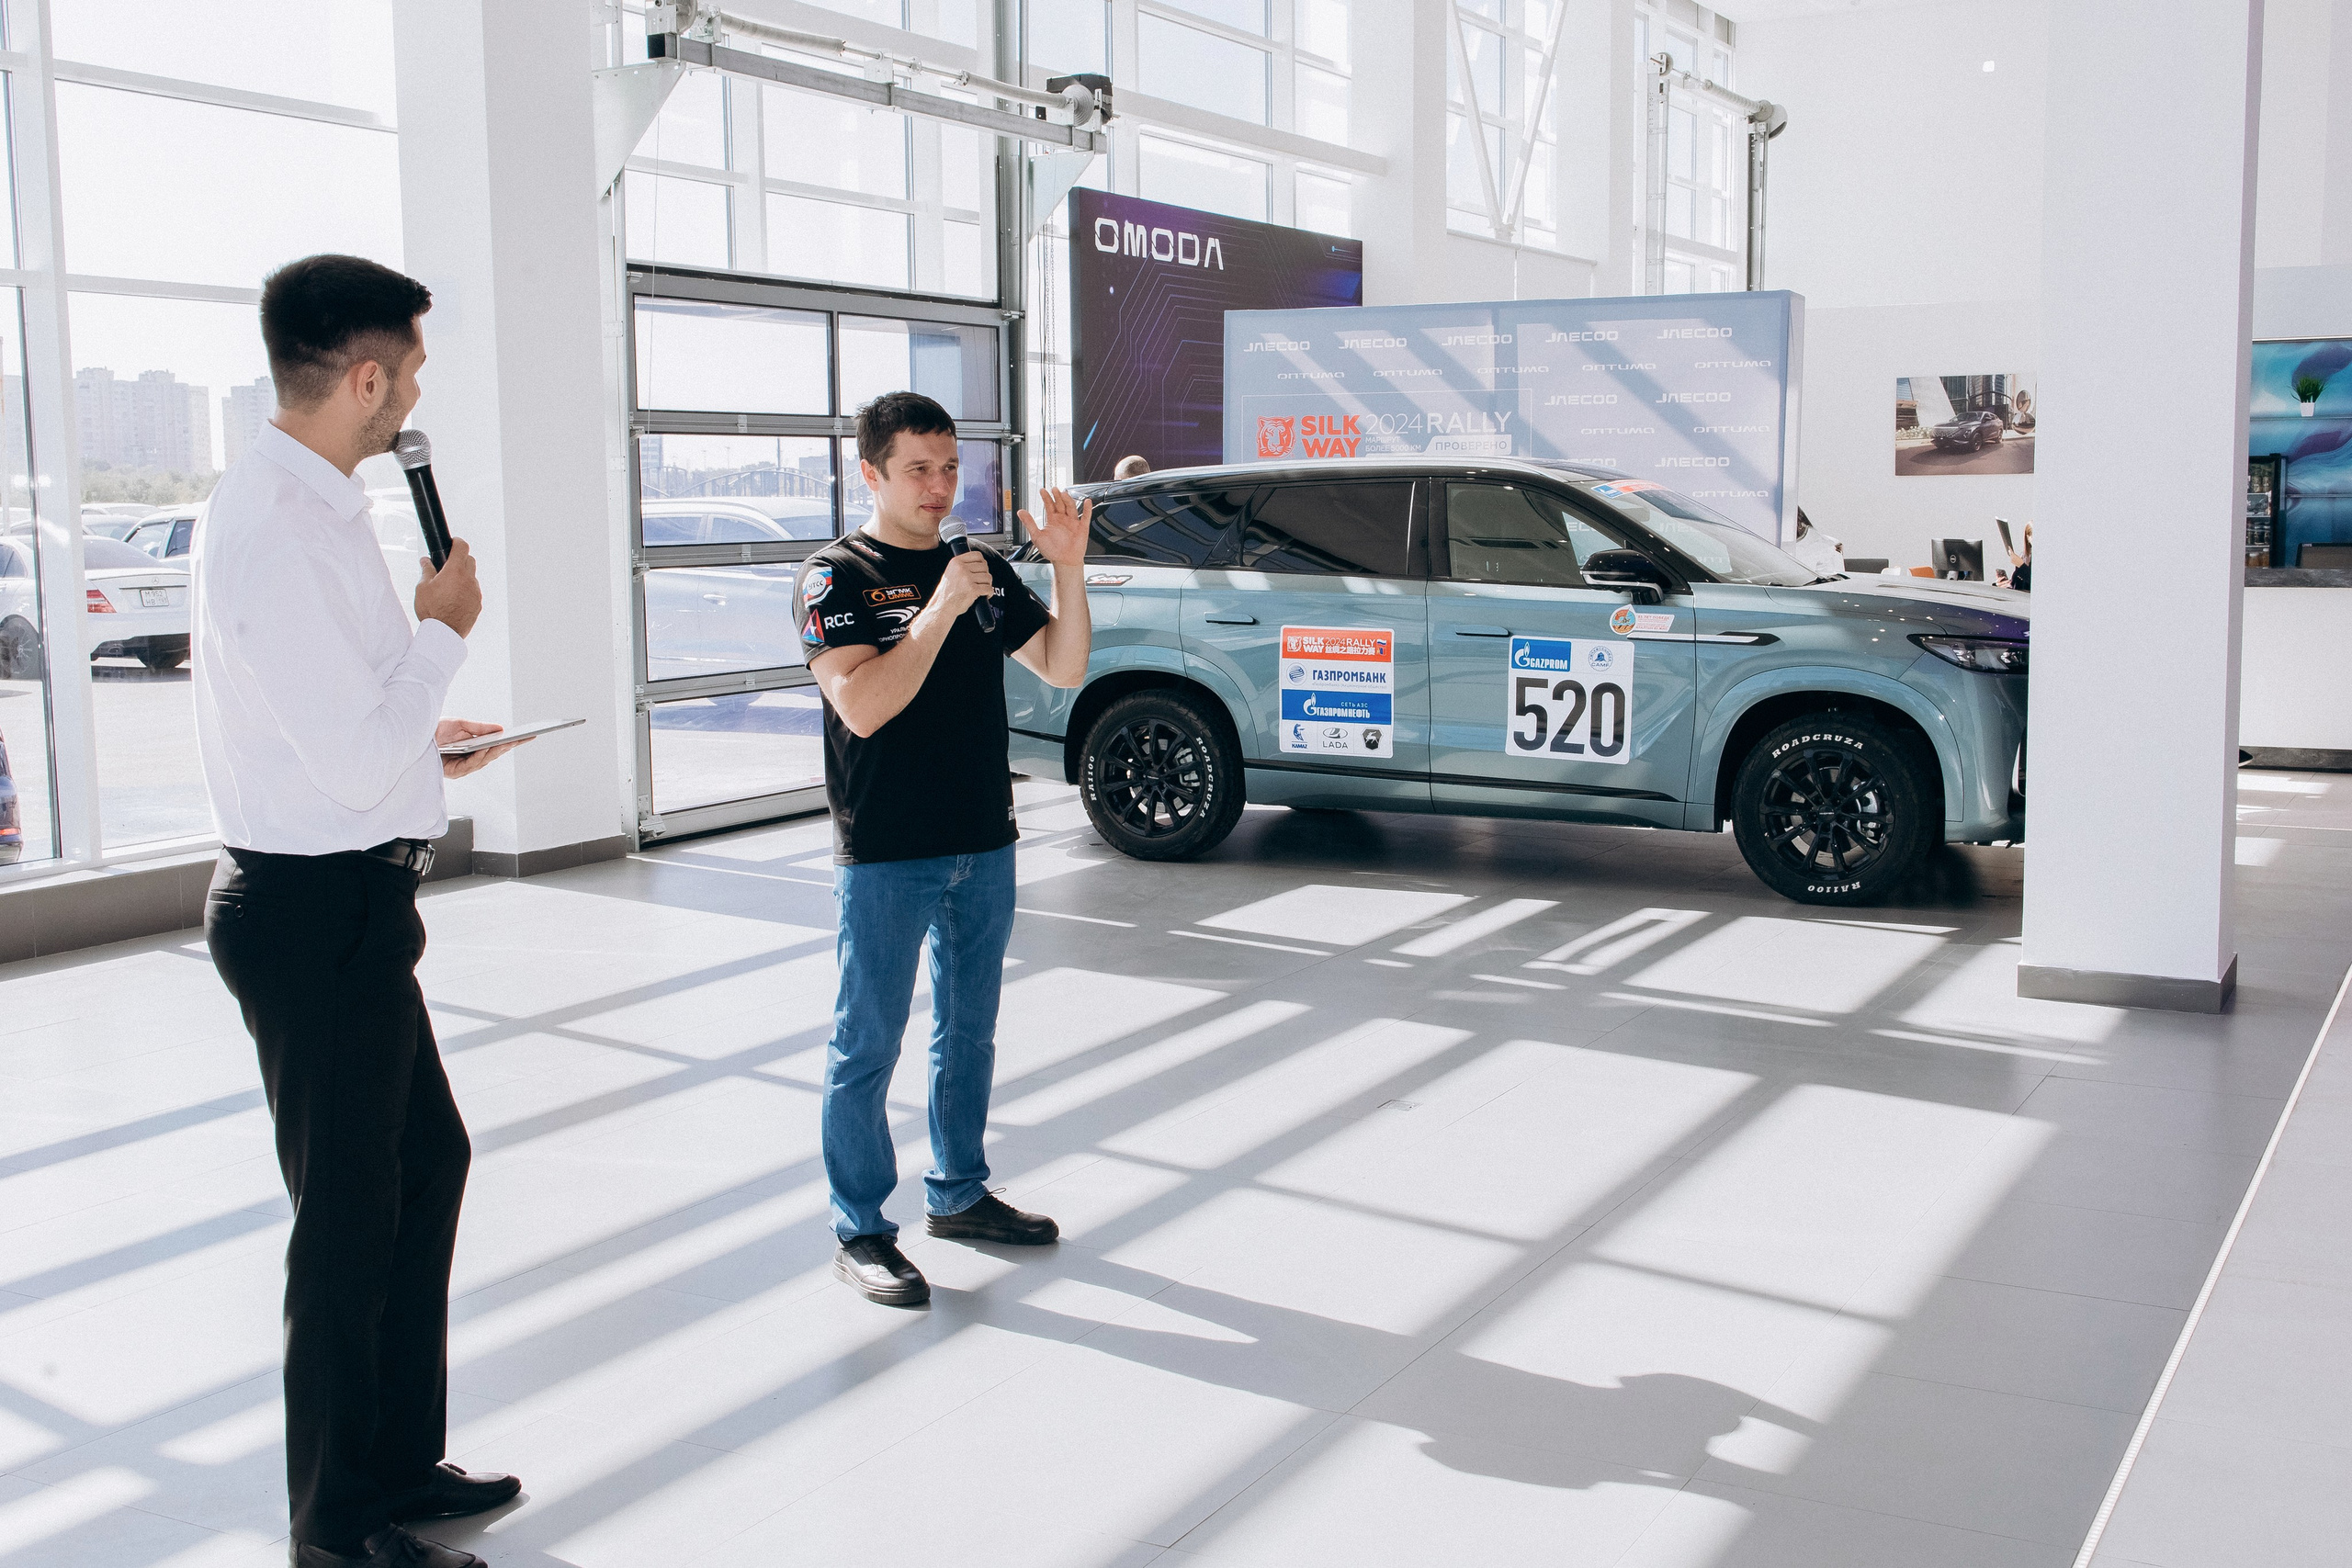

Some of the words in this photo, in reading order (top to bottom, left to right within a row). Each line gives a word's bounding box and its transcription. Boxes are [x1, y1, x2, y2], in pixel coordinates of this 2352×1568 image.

[1095, 218, 1224, 270] OMODA
[1545, 331, 1619, 343] JAECOO
[1657, 327, 1732, 340] JAECOO
[1339, 338, 1407, 349] JAECOO
[1442, 334, 1512, 346] JAECOO
[1243, 341, 1310, 352] JAECOO
[1544, 394, 1617, 405] JAECOO
[1656, 391, 1731, 403] JAECOO
[1301, 414, 1362, 435] SILK
[1365, 413, 1423, 434] 2024
[1427, 412, 1511, 434] RALLY
[1301, 437, 1362, 458] WAY
[1435, 441, 1508, 450] ПРОВЕРЕНО
[1654, 457, 1729, 468] JAECOO
[824, 613, 854, 629] RCC
[1303, 637, 1324, 645] SILK
[1325, 637, 1346, 646] 2024
[1347, 638, 1375, 647] RALLY
[1303, 645, 1324, 653] WAY
[1530, 658, 1568, 670] GAZPROM
[1312, 670, 1386, 682] ГАЗПРОМБАНК
[1513, 676, 1626, 757] 520
[1771, 734, 1864, 758] ROADCRUZA
[1195, 737, 1214, 818] ROADCRUZA
